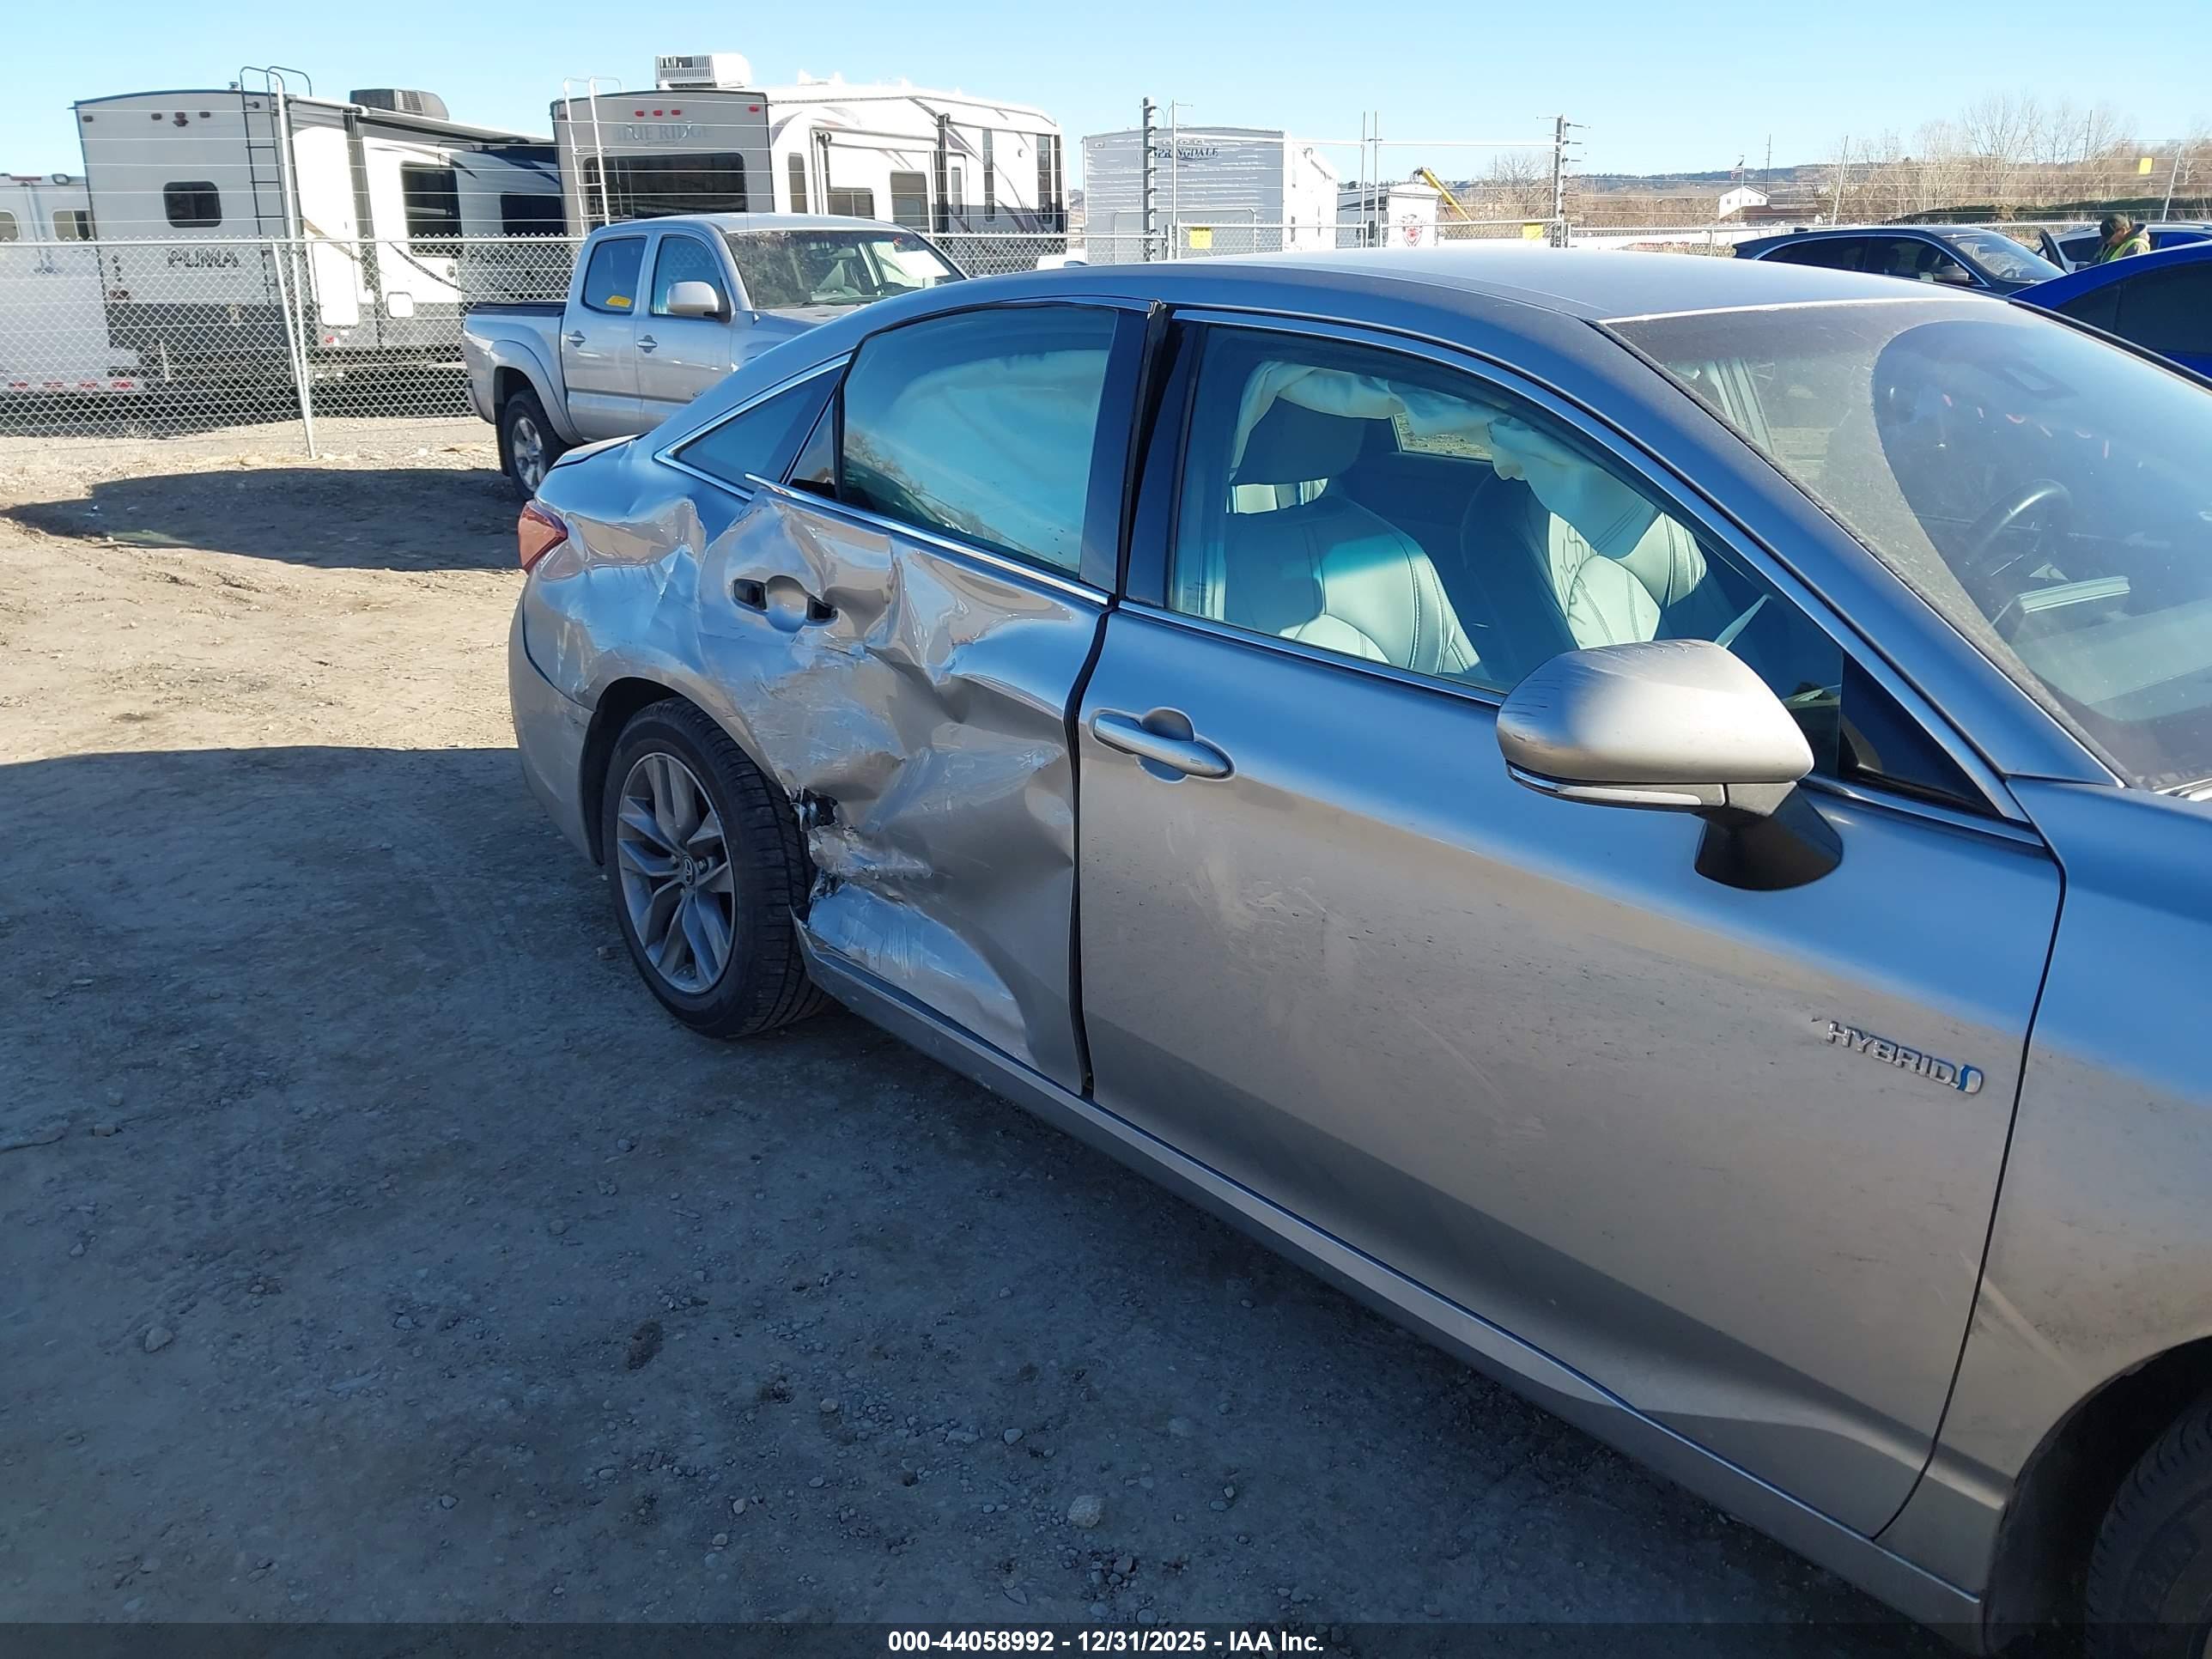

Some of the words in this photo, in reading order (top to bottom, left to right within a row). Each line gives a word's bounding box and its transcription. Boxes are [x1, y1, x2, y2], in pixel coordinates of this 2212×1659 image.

[1152, 147, 1219, 159] SPRNGDALE
[167, 249, 240, 268] PUMA
[1826, 1021, 1958, 1087] HYBRID
